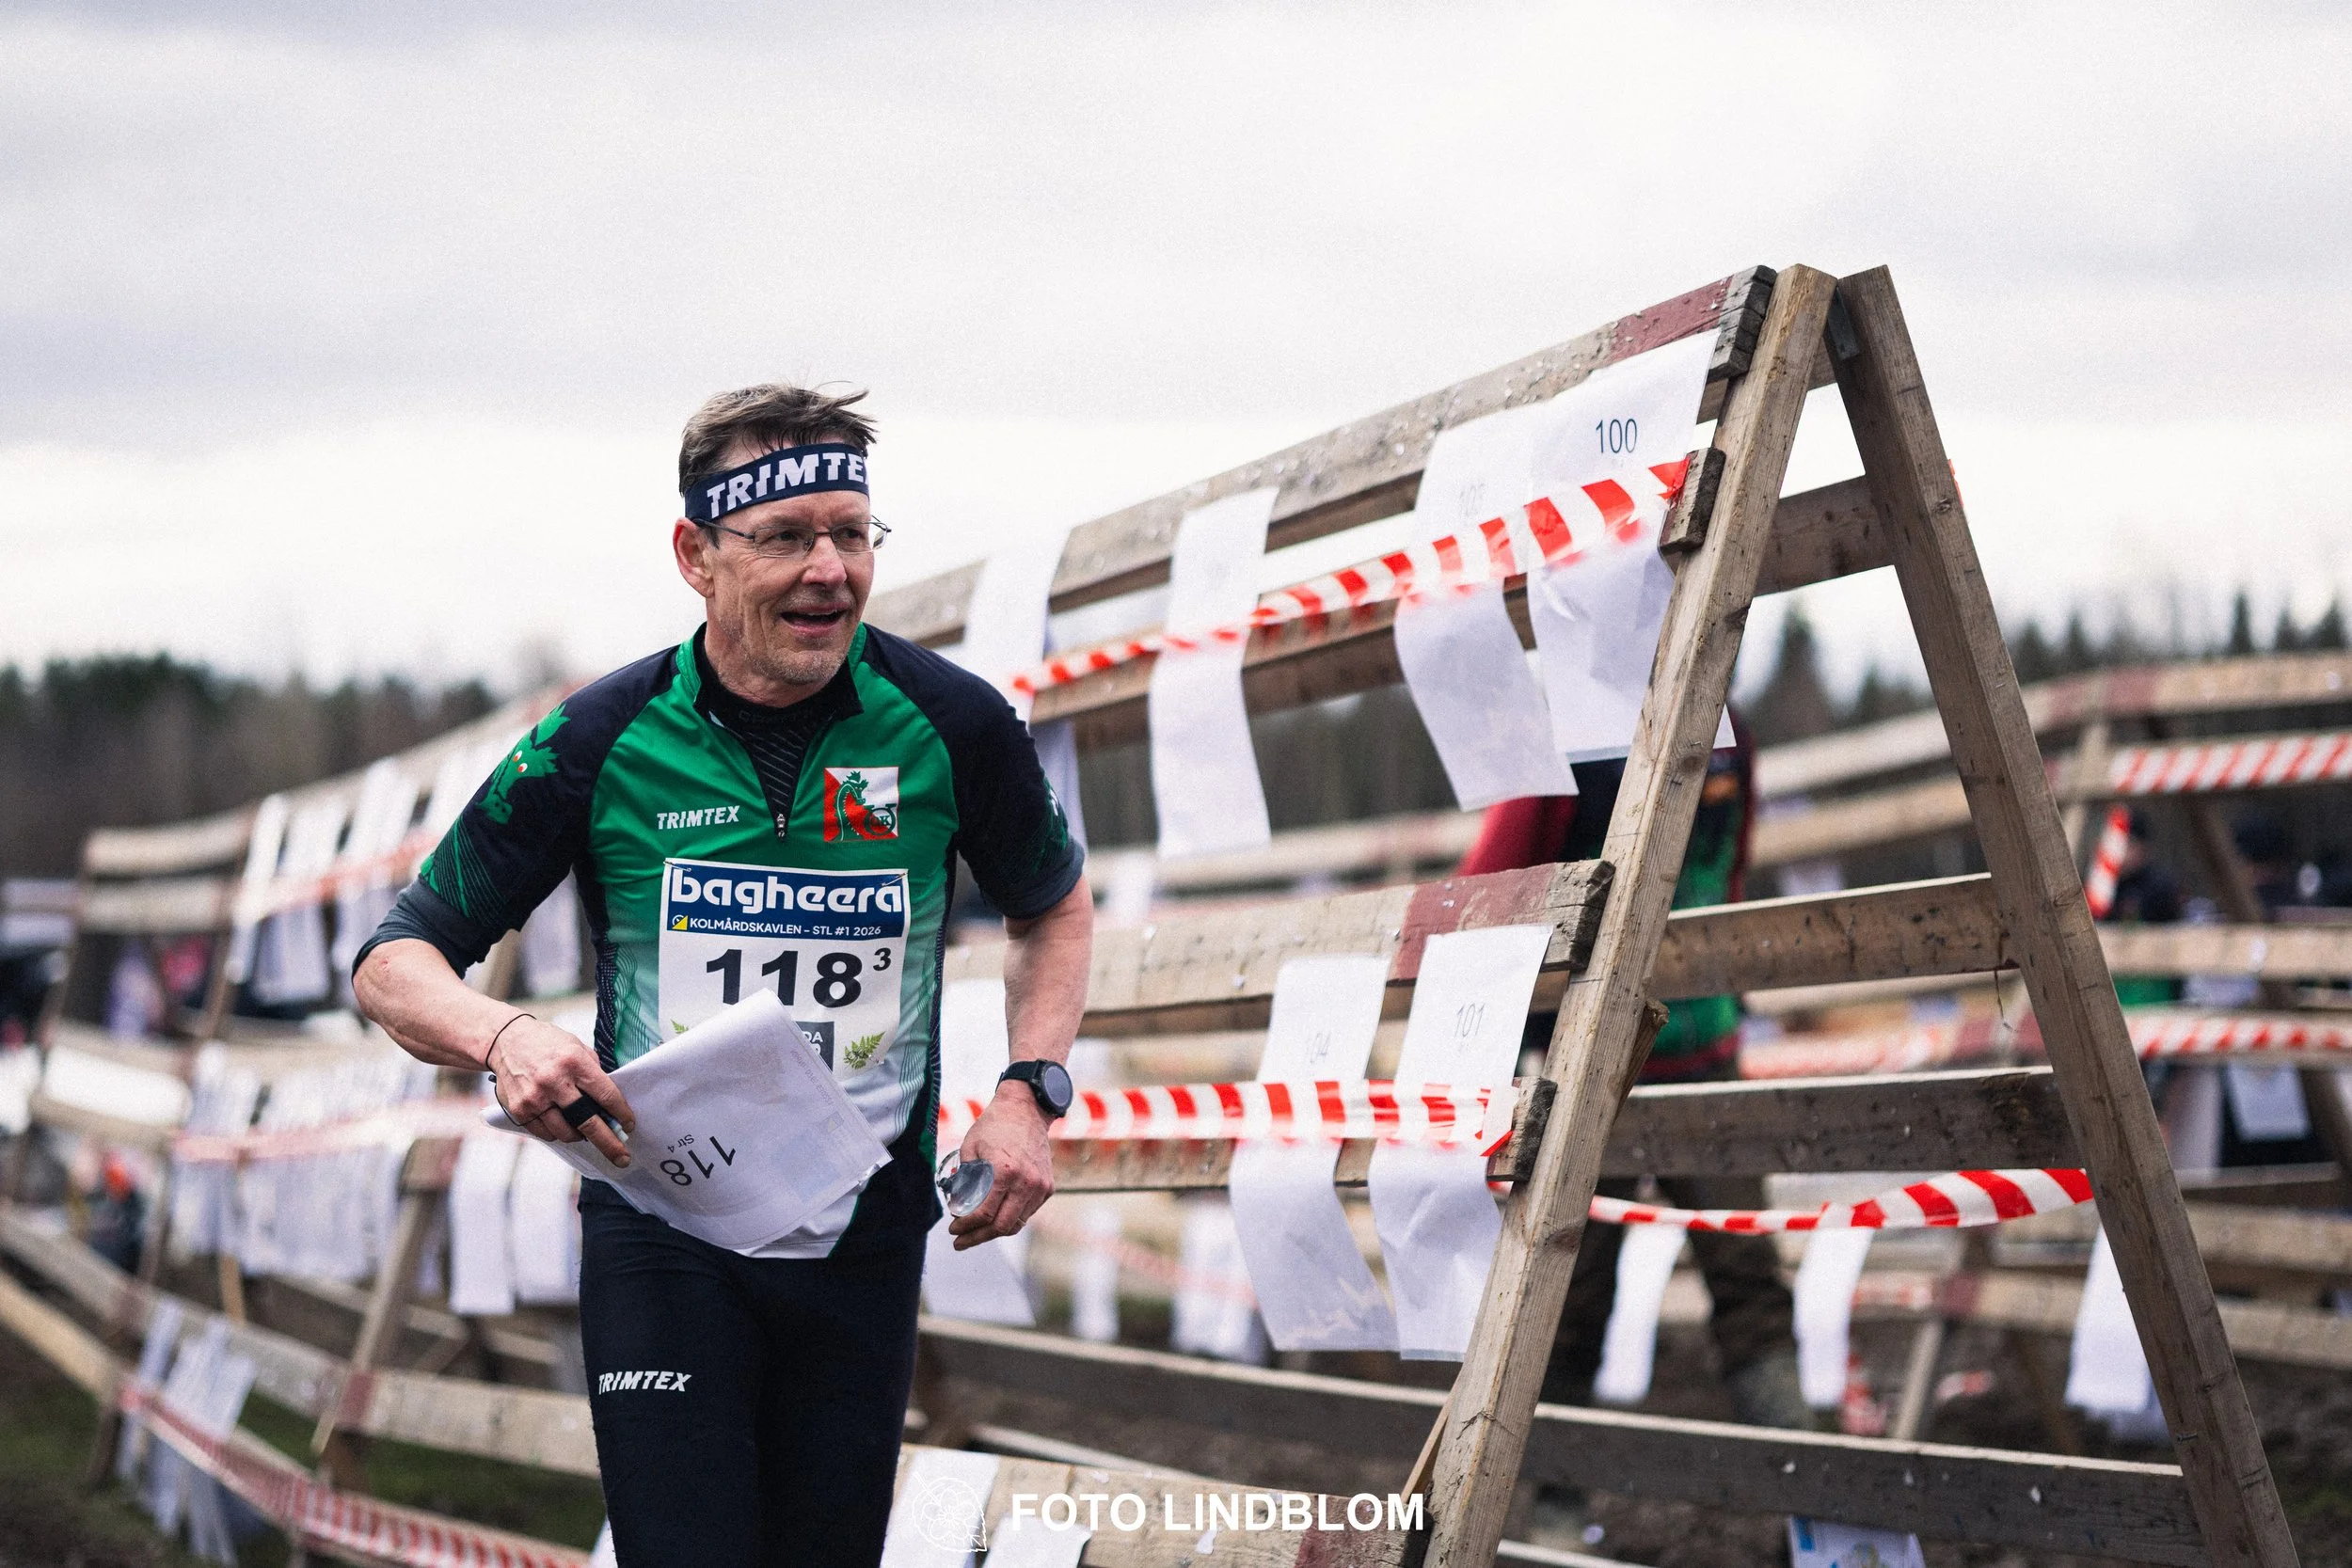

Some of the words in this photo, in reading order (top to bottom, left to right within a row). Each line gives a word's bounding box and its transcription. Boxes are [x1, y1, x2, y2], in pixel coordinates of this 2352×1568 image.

[1595, 419, 1638, 453] 100
[707, 451, 868, 518] TRIMTE
[657, 805, 740, 831] TRIMTEX
[671, 868, 903, 914] bagheera
[690, 917, 802, 935] KOLMÅRDSKAVLEN
[812, 925, 833, 936] STL
[834, 926, 850, 936] #1
[853, 926, 882, 937] 2026
[706, 948, 863, 1008] 118
[872, 947, 892, 972] 3
[1454, 1002, 1486, 1038] 101
[667, 1145, 675, 1153] 4
[676, 1133, 695, 1148] Str
[660, 1135, 737, 1187] 118
[598, 1370, 691, 1395] TRIMTEX
